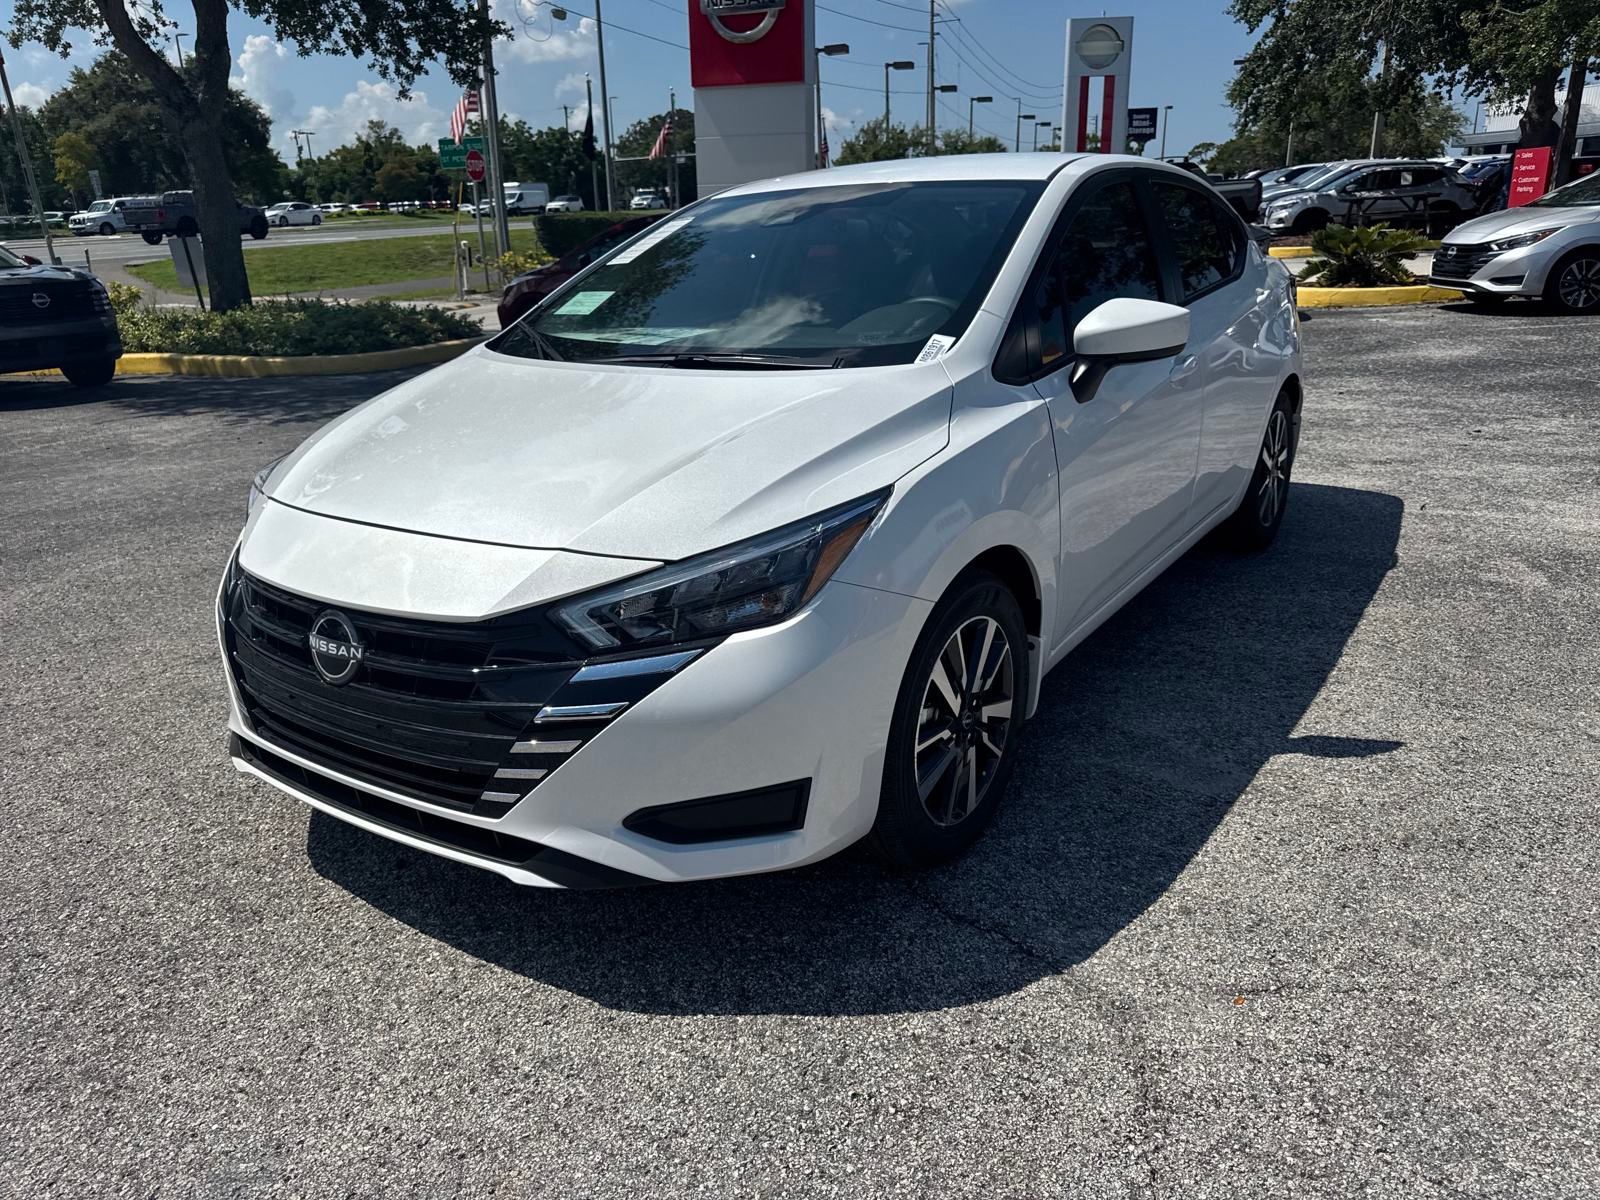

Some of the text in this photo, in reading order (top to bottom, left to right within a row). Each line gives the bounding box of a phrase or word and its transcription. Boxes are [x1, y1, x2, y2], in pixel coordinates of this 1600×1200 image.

[707, 0, 777, 8] NISS
[467, 159, 483, 171] STOP
[309, 635, 362, 659] NISSAN
